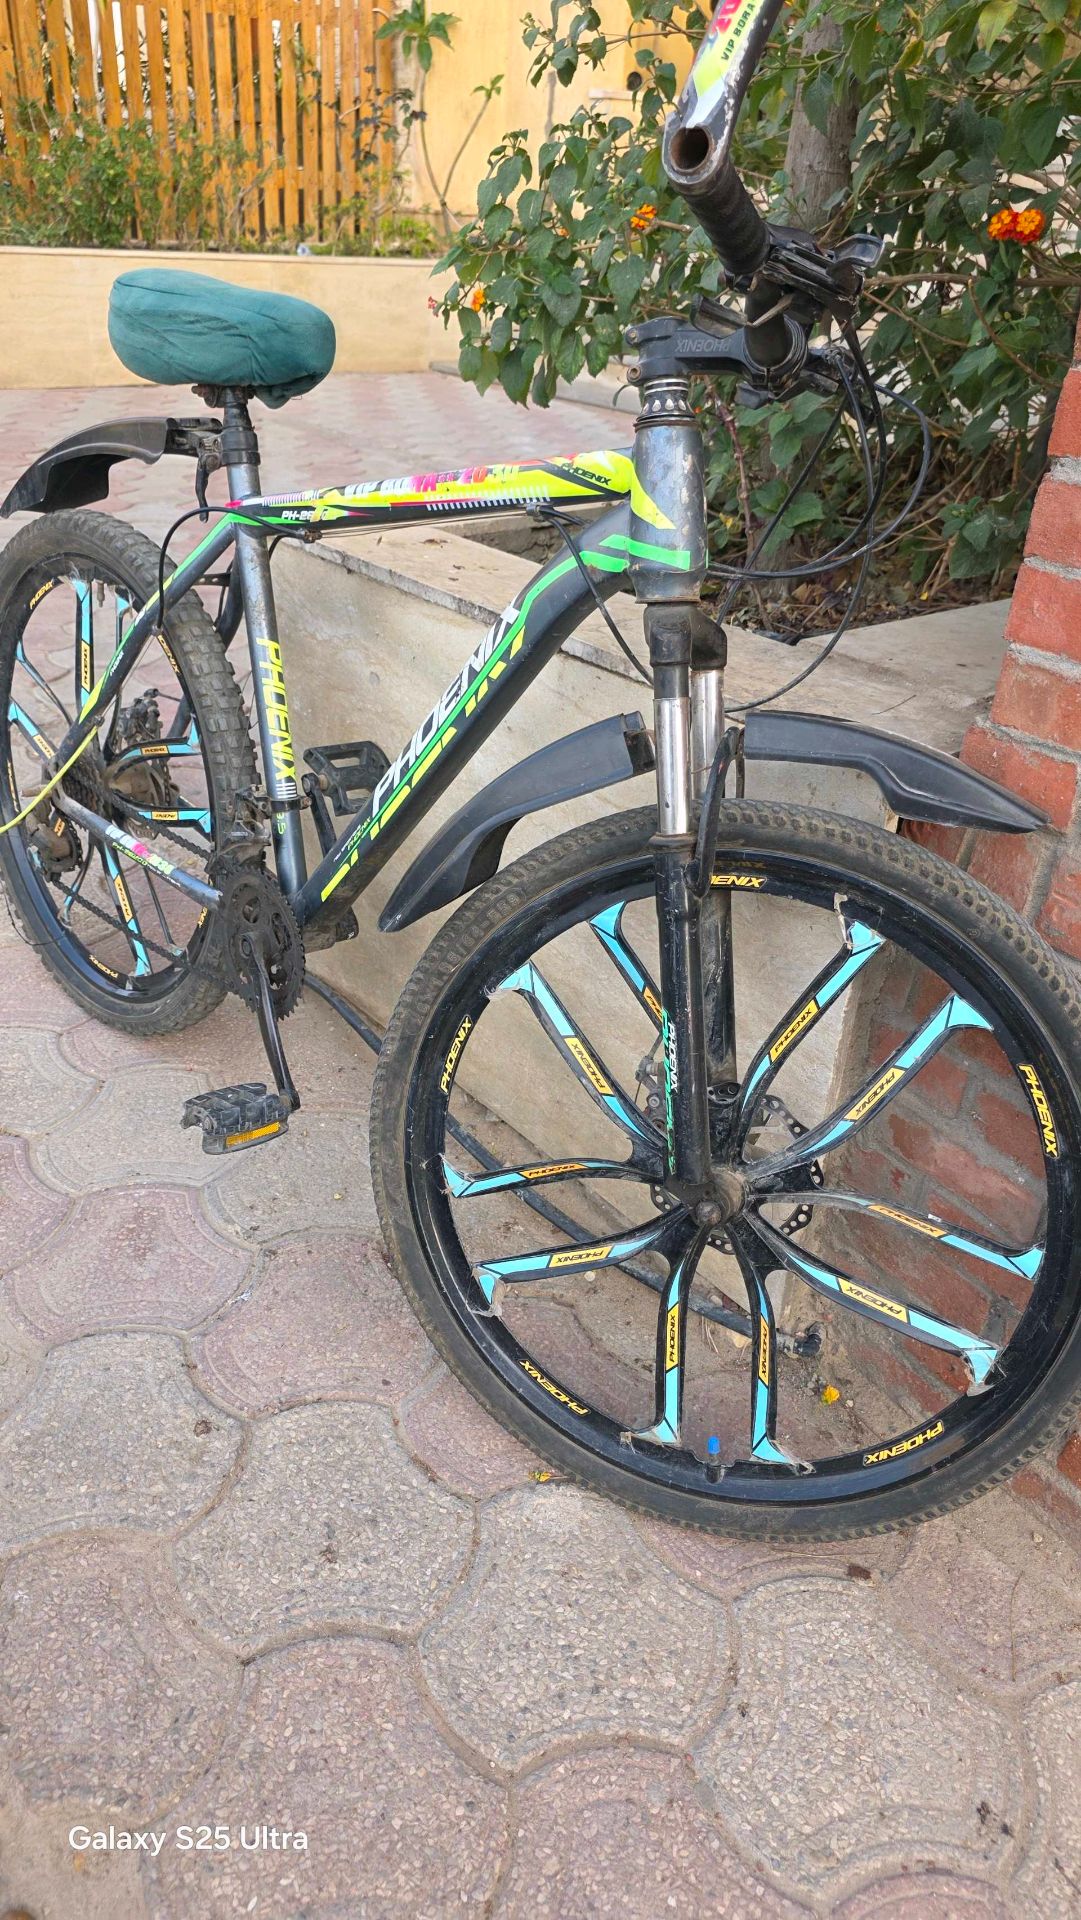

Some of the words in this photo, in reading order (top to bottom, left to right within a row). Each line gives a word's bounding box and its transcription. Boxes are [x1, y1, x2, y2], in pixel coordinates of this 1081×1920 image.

[721, 38, 735, 61] VIP
[674, 339, 732, 353] PHOENIX
[561, 462, 612, 486] PHOENIX
[255, 636, 297, 782] PHOENIX
[373, 607, 521, 818] PHOENIX
[775, 1008, 812, 1053] PHOENIX
[440, 1016, 472, 1094] PHOENIX
[571, 1043, 606, 1089] PHOENIX
[667, 1020, 679, 1094] PHOENIX
[856, 1072, 896, 1116] PHOENIX
[1018, 1065, 1058, 1158] PHOENIX
[528, 1164, 576, 1177] PHOENIX
[556, 1250, 604, 1264] PHOENIX
[846, 1286, 903, 1315] PHOENIX
[519, 1360, 589, 1415] PHOENIX
[865, 1421, 943, 1464] PHOENIX
